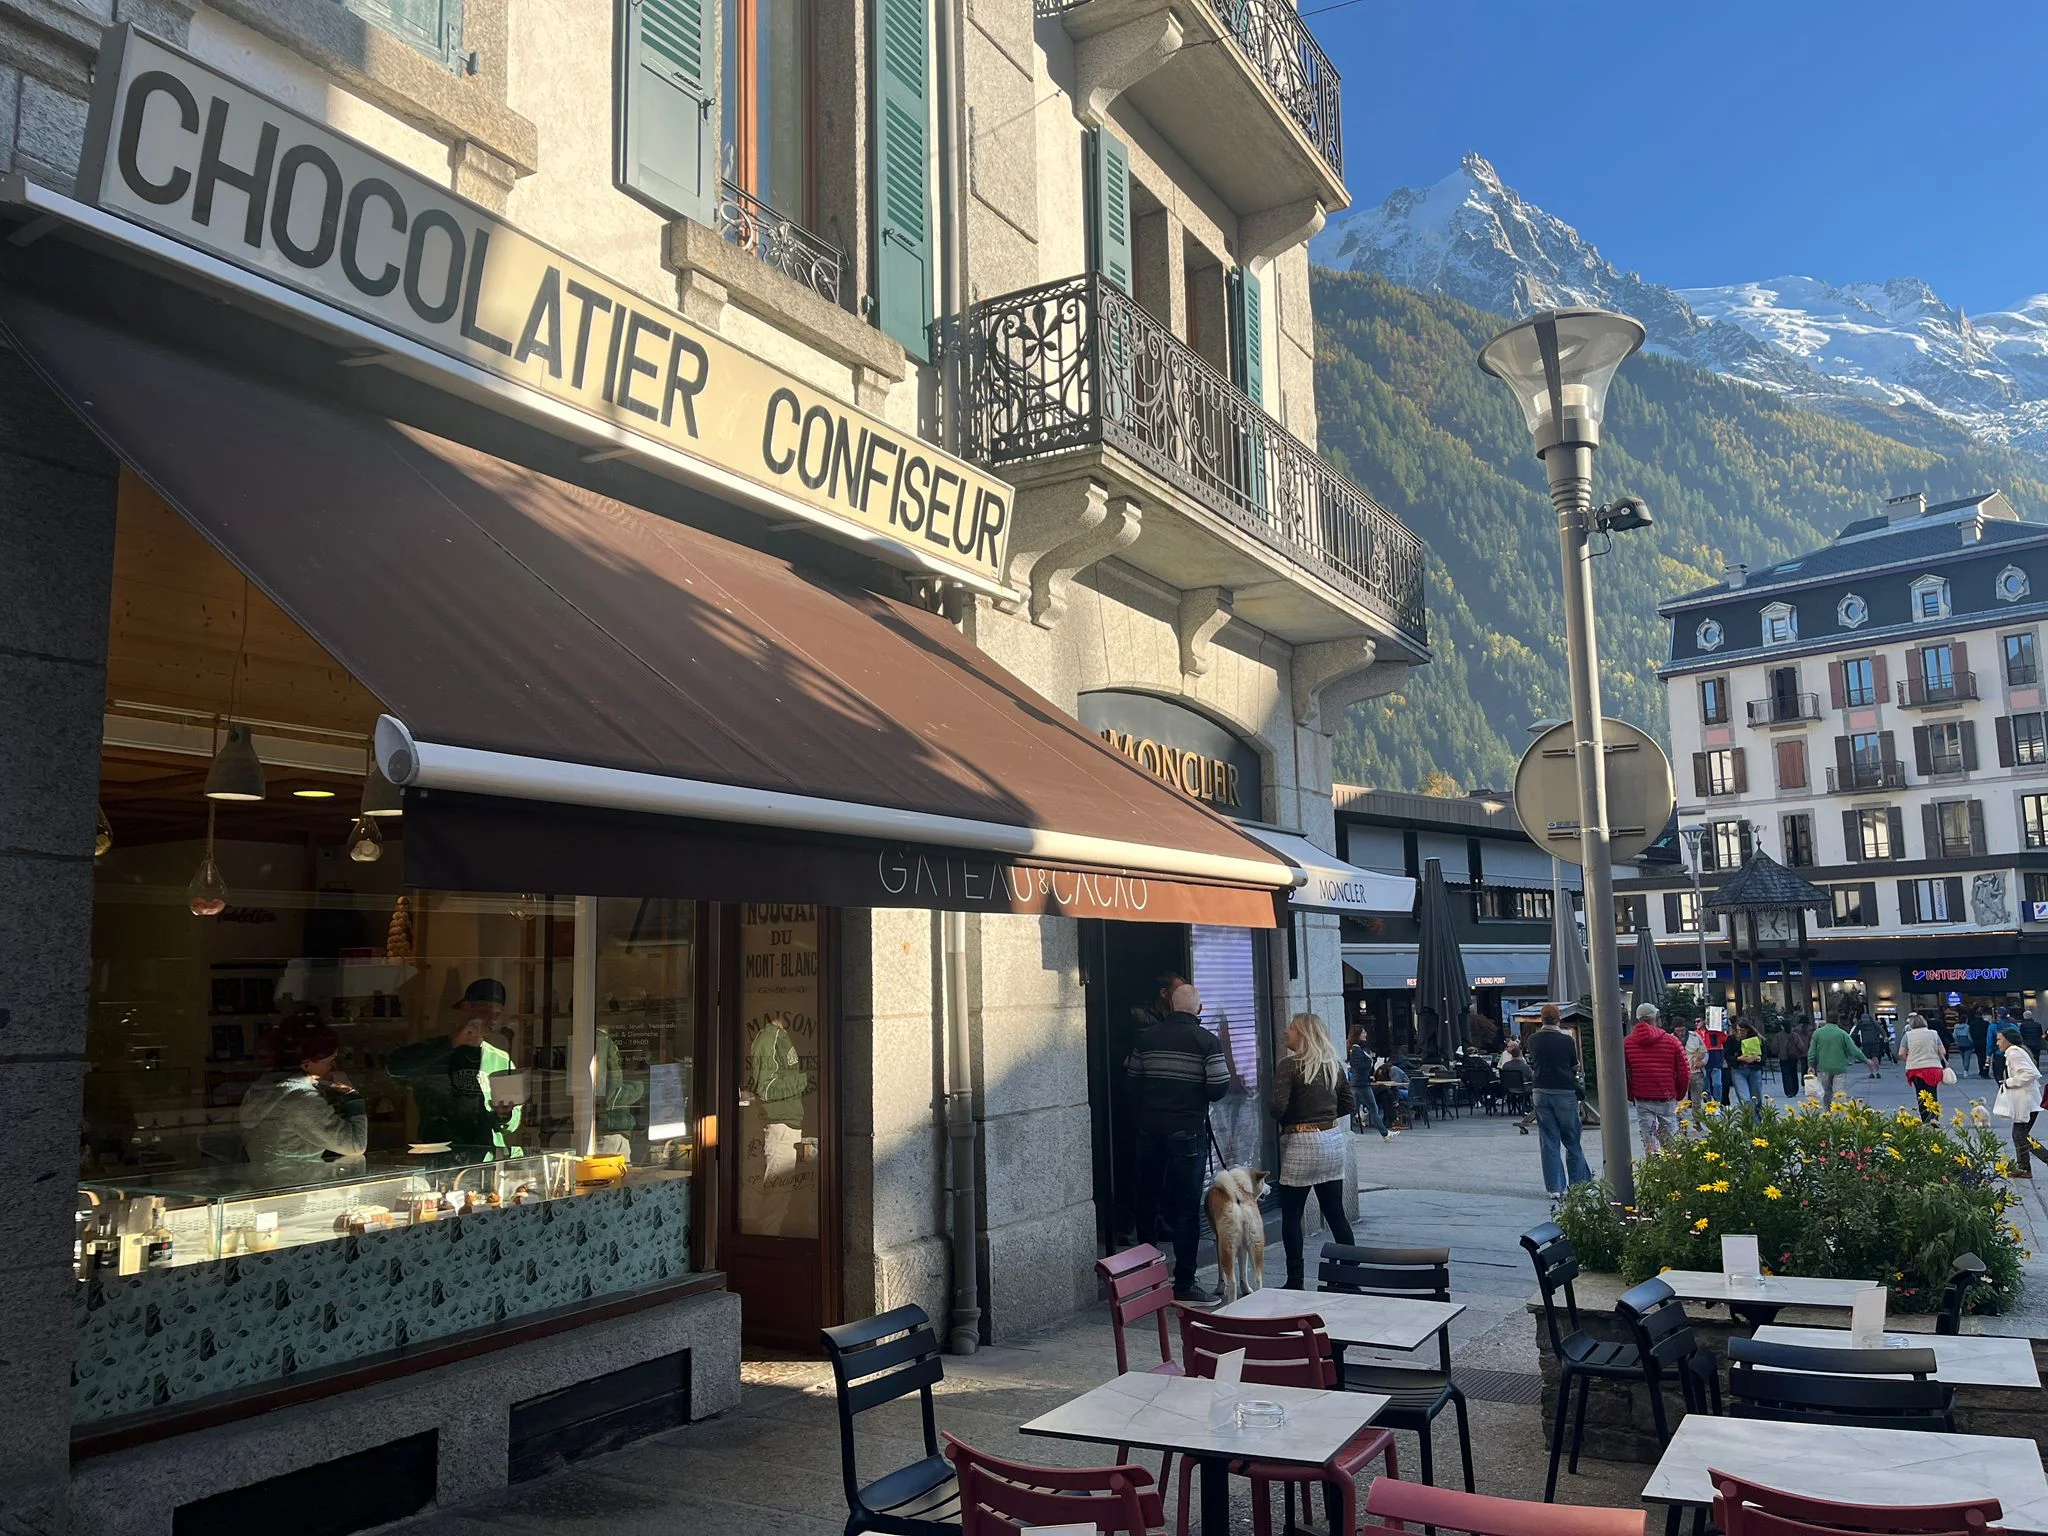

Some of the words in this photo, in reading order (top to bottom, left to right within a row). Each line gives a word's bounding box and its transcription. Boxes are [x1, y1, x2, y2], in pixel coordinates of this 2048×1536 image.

[117, 69, 709, 440] CHOCOLATIER
[762, 387, 1006, 567] CONFISEUR
[1319, 879, 1367, 904] MONCLER
[769, 930, 792, 946] DU
[1925, 968, 2008, 980] INTERSPORT
